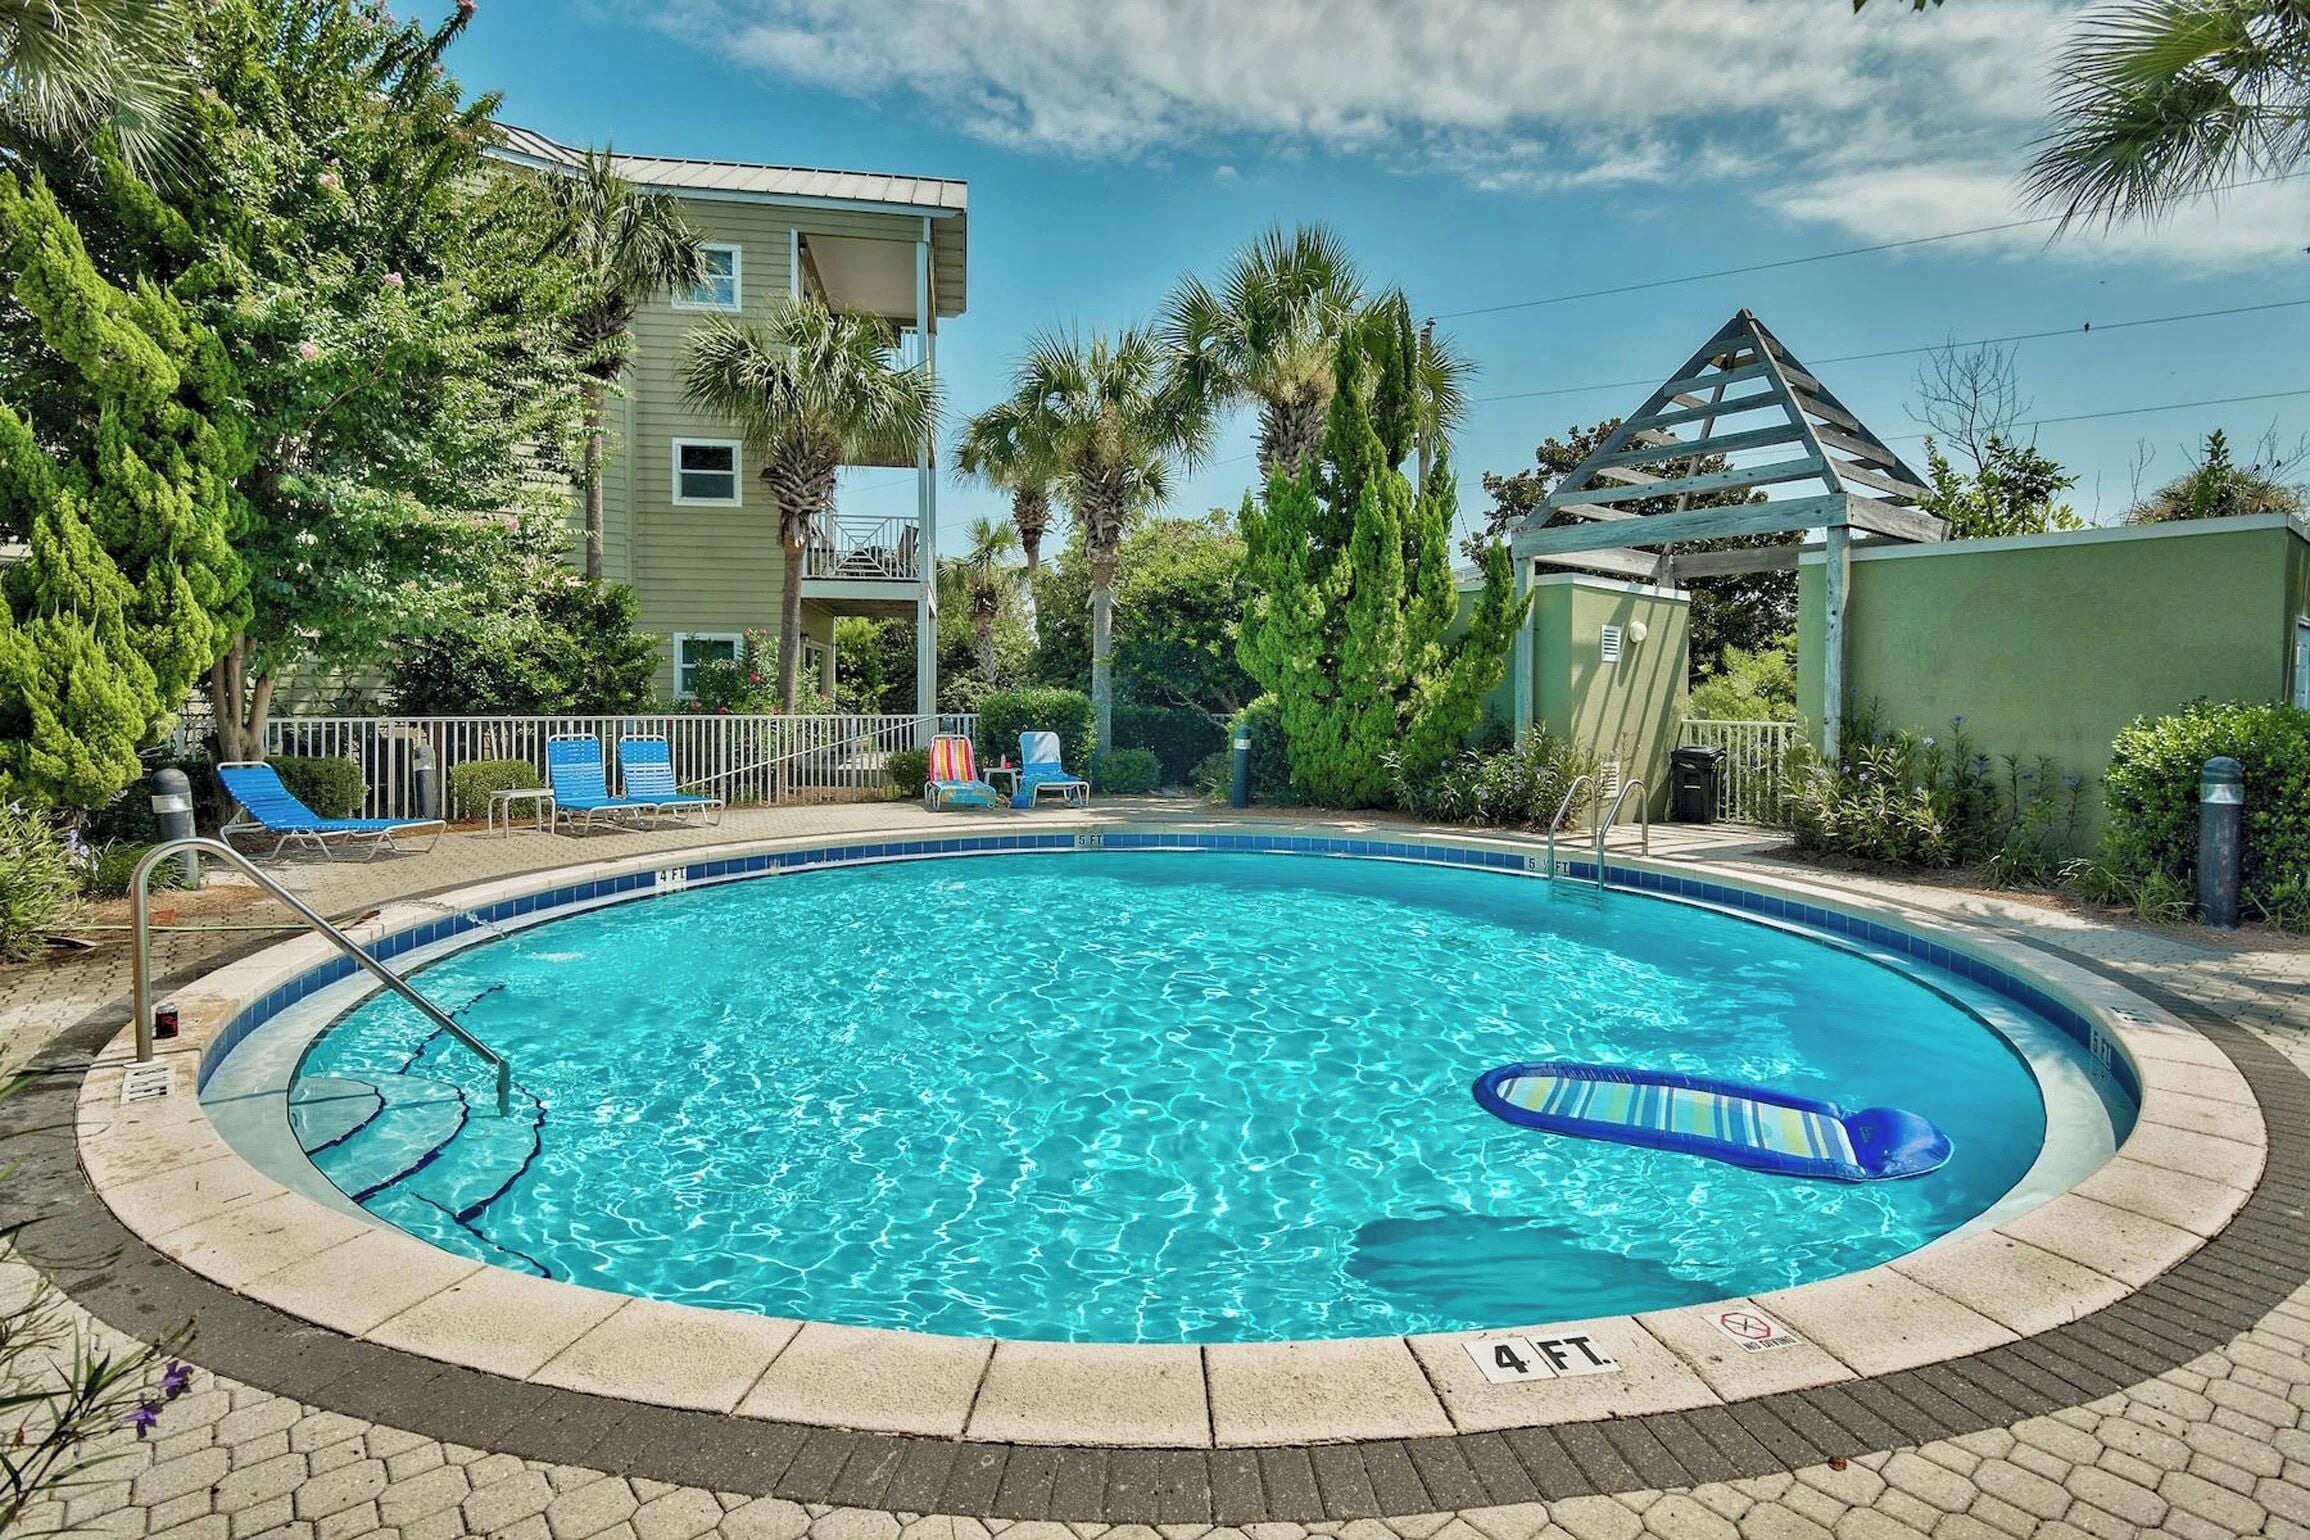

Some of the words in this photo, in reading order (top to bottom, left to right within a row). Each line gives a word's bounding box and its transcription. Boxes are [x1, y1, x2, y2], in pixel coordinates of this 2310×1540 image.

[1079, 834, 1085, 845] 5
[1090, 834, 1102, 845] FT
[1529, 857, 1536, 869] 5
[1555, 861, 1568, 873] FT
[660, 870, 667, 881] 4
[672, 866, 685, 880] FT
[1742, 1341, 1761, 1351] NO
[1494, 1344, 1530, 1374] 4
